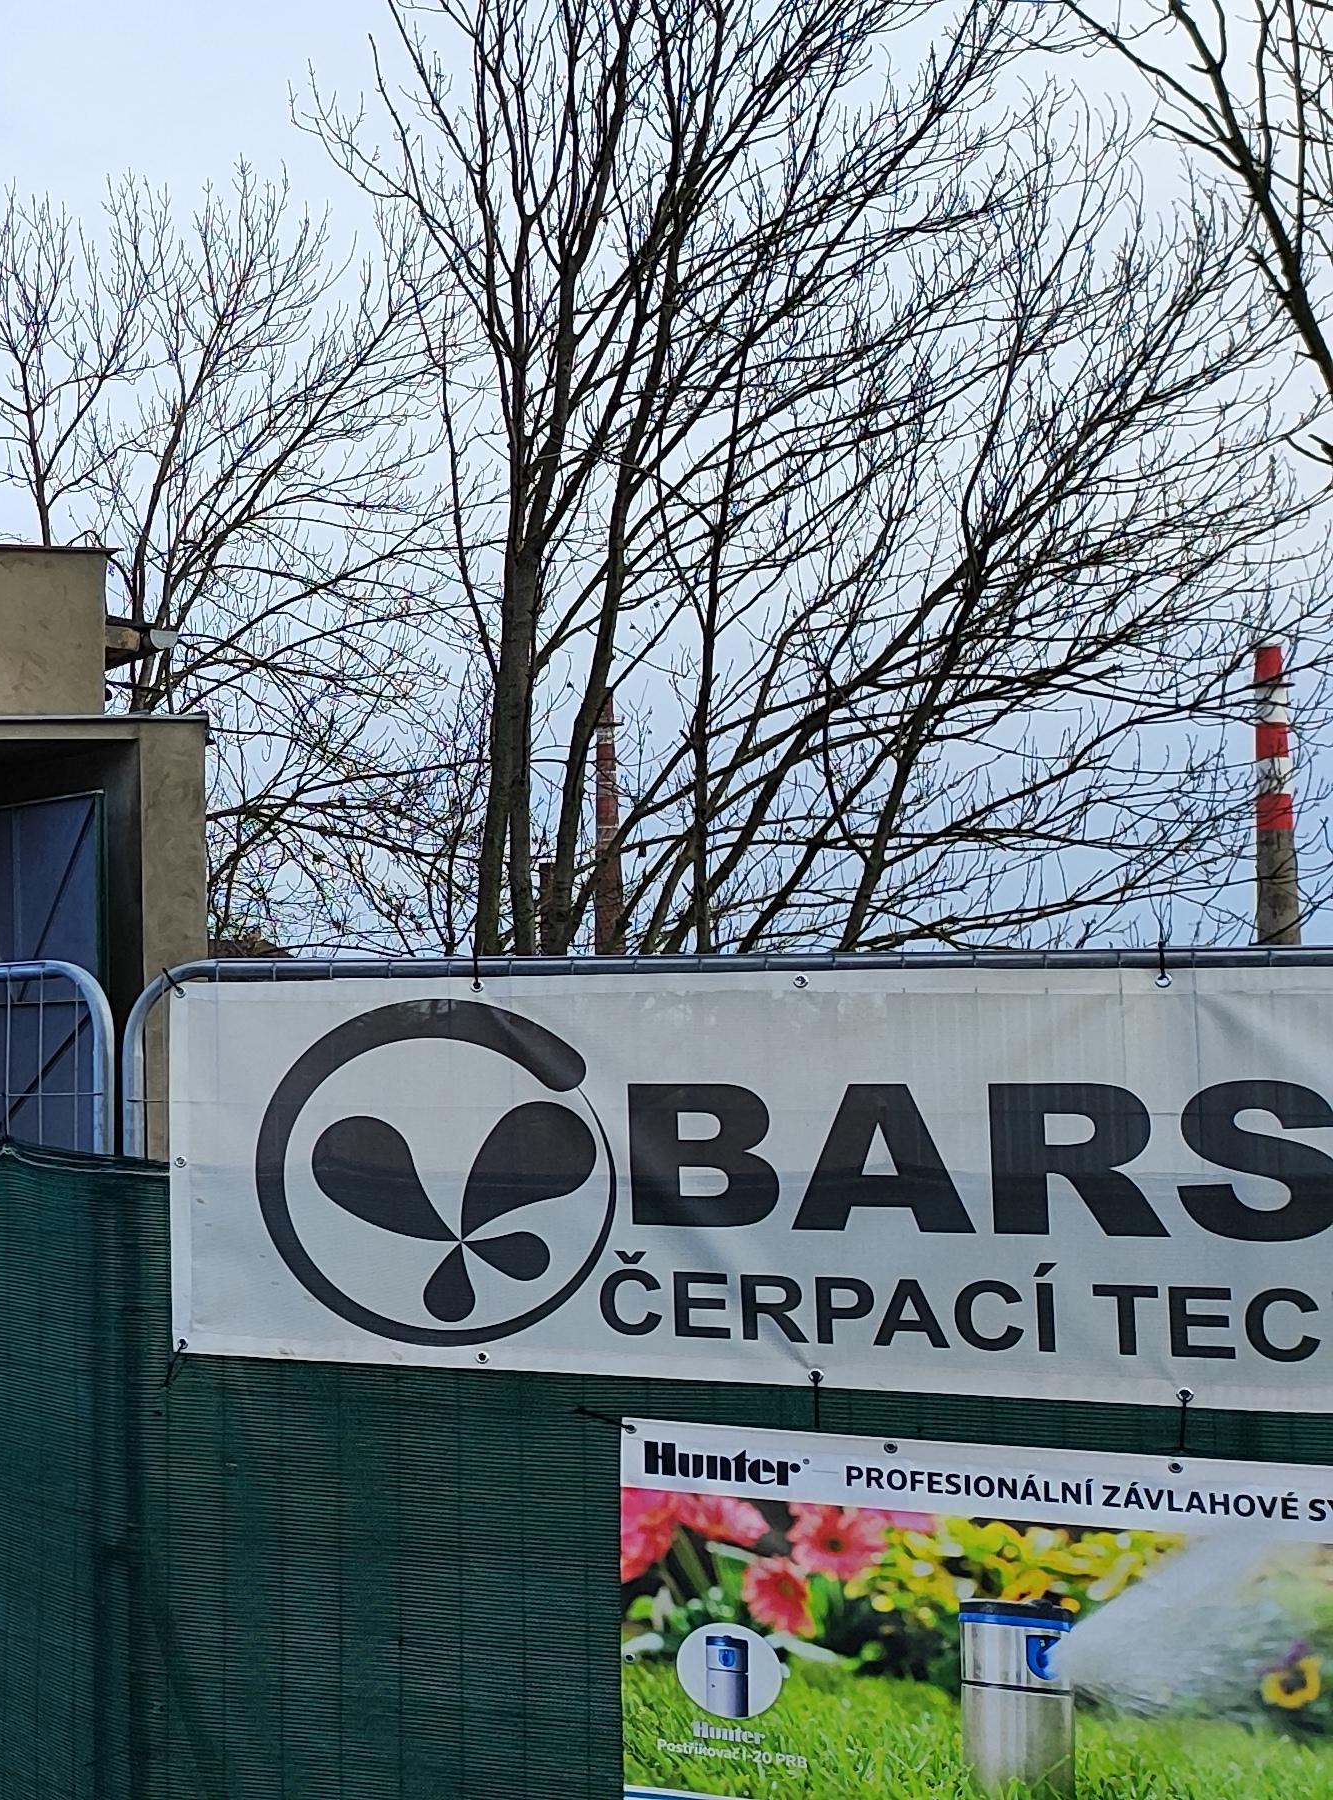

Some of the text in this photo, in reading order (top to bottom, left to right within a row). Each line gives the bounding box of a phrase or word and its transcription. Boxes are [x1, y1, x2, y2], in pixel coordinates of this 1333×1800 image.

[627, 1079, 1333, 1242] BARS
[599, 1250, 1322, 1362] ČERPACÍ TEC
[644, 1440, 803, 1486] Hunter
[846, 1465, 1094, 1506] PROFESIONÁLNÍ
[1102, 1481, 1300, 1520] ZÁVLAHOVÉ
[657, 1738, 740, 1761] Postřikovač
[775, 1751, 808, 1769] PRB
[692, 1720, 765, 1745] Hunter
